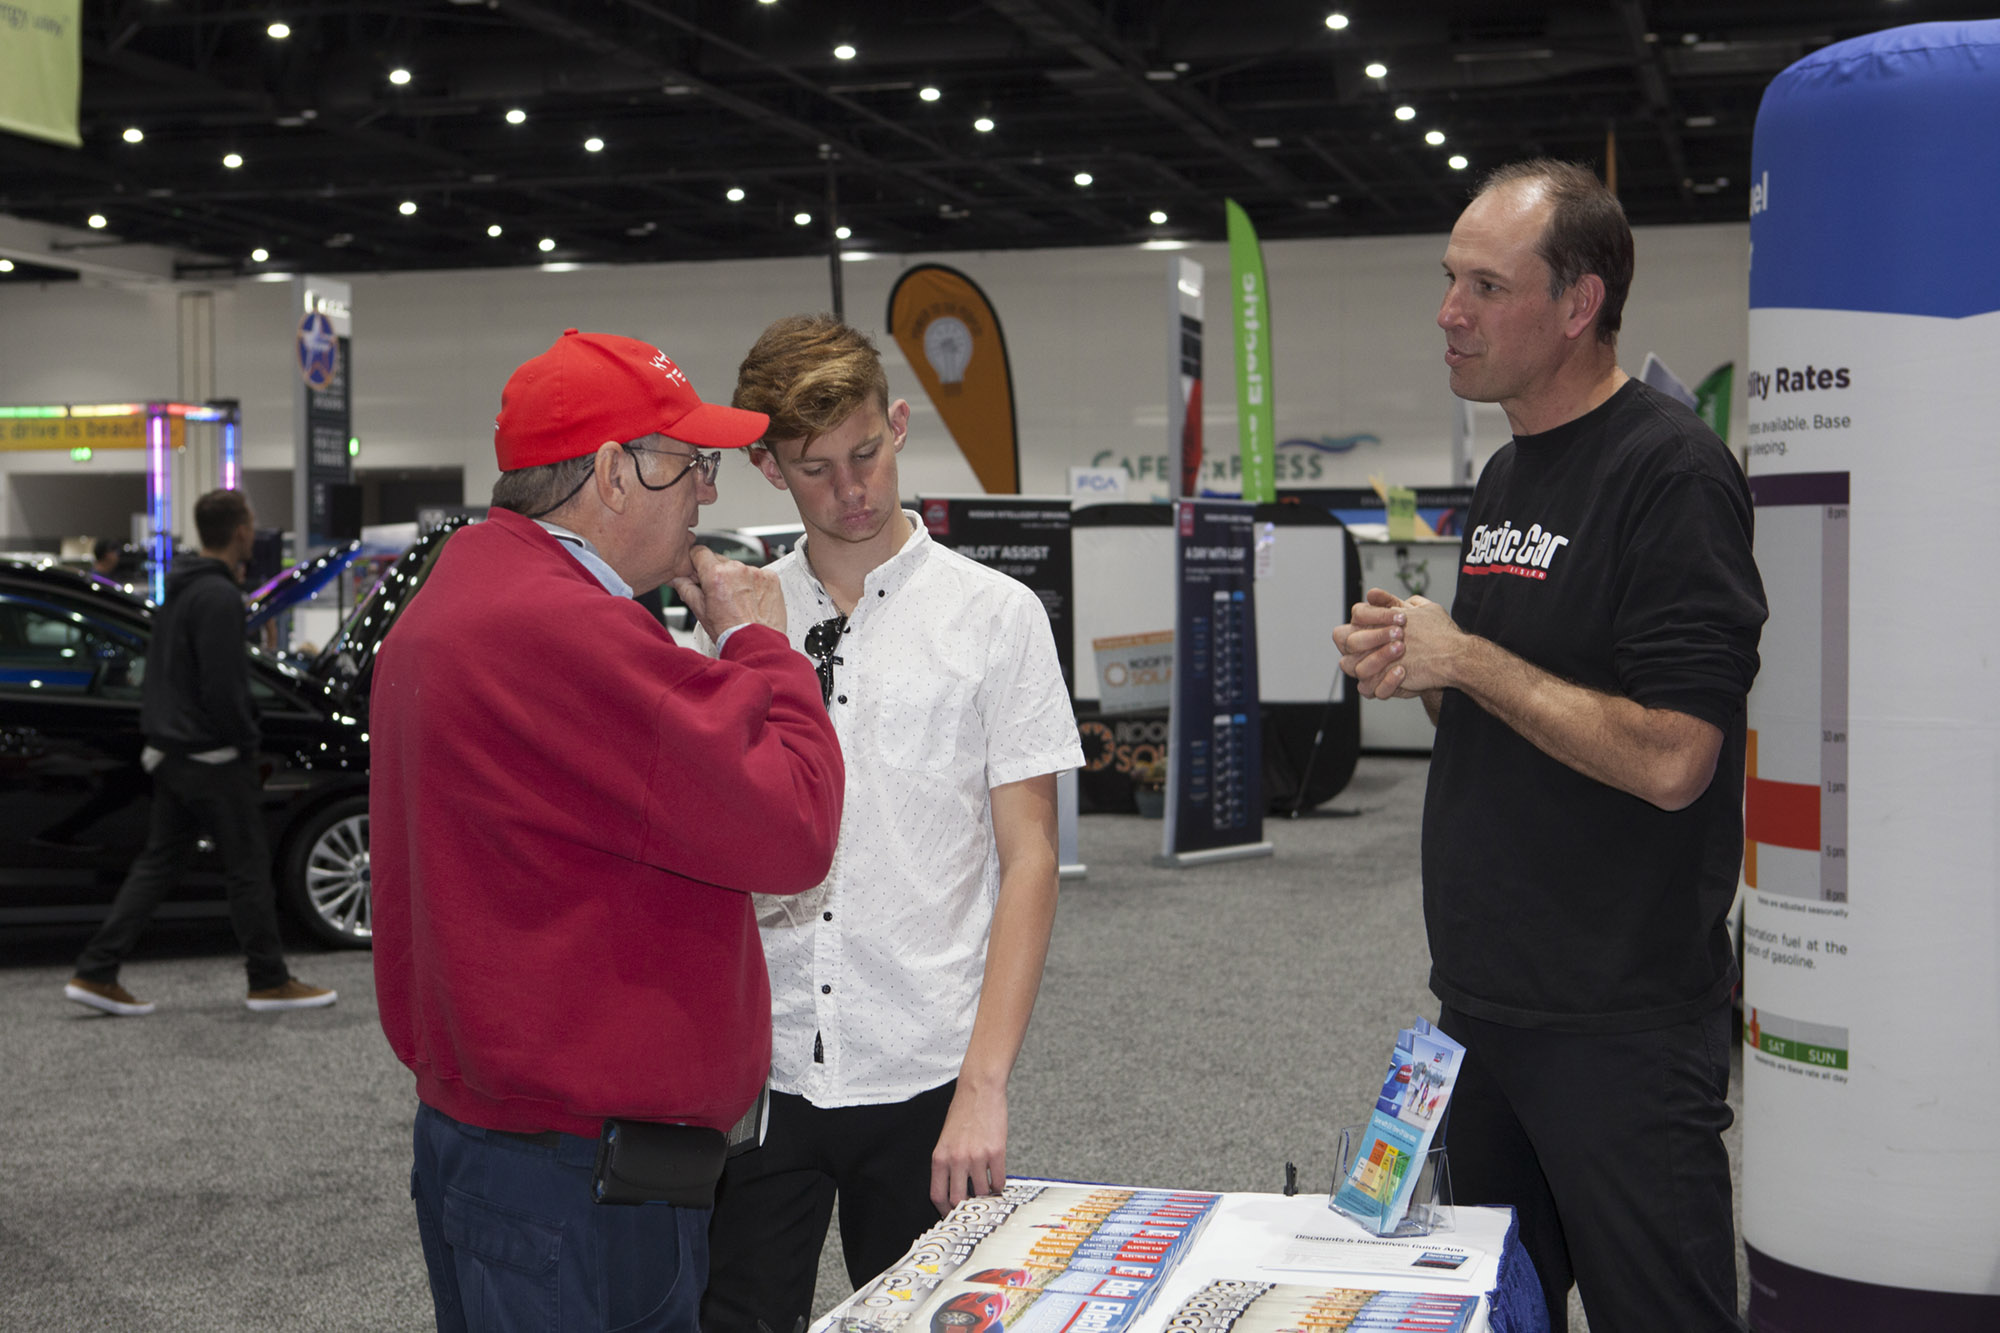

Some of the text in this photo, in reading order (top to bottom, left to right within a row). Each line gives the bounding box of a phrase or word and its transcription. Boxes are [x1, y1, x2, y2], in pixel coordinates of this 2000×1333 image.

[1775, 365, 1851, 393] Rates
[1812, 414, 1851, 430] Base
[1076, 475, 1118, 491] FCA
[1000, 545, 1050, 560] ASSIST
[1515, 523, 1569, 570] Car
[1782, 933, 1801, 949] fuel
[1806, 940, 1819, 952] at
[1825, 941, 1848, 956] the
[1771, 950, 1816, 969] gasoline.
[1767, 1038, 1786, 1054] SAT
[1808, 1049, 1837, 1066] SUN
